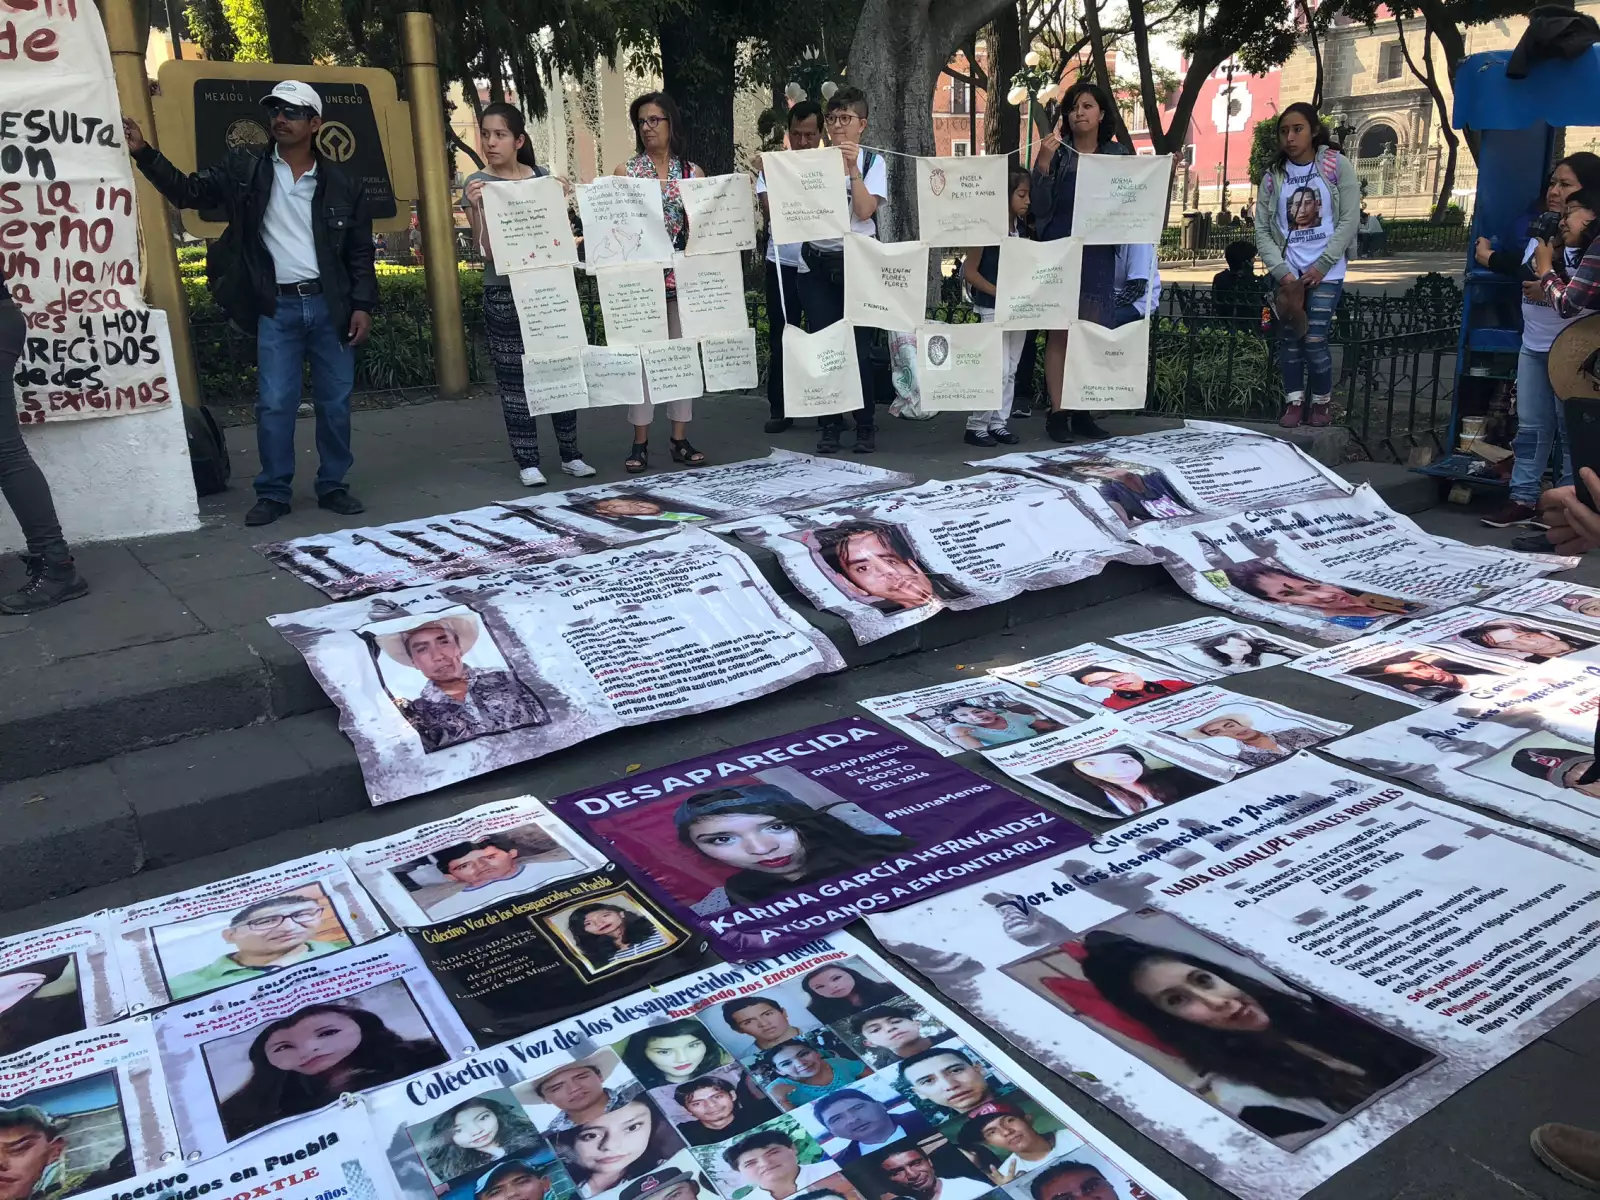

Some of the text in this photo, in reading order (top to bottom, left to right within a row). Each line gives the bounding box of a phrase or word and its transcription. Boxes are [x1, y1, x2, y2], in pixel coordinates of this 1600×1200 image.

[204, 92, 243, 102] MEXICO
[325, 95, 364, 104] UNESCO
[95, 177, 133, 216] in
[0, 214, 114, 254] erno
[103, 309, 150, 337] HOY
[654, 663, 746, 689] Camisa cuadros color
[692, 661, 716, 672] frontal
[691, 683, 706, 692] azul
[727, 671, 749, 684] botas
[617, 708, 633, 717] con
[574, 727, 879, 816] DESAPARECIDA
[846, 757, 903, 779] EL 26 DE
[856, 764, 917, 787] AGOSTO
[869, 771, 931, 793] DEL 2016
[883, 783, 992, 821] #NiUnaMenos
[1089, 818, 1169, 854] Colectivo
[1160, 788, 1404, 898] NADIA GUADALUPE MORALES ROSALES
[1329, 834, 1366, 854] OCTUBRE
[1351, 838, 1377, 855] LOMAS
[995, 793, 1300, 916] Voz de los desaparecidos en Puebla
[1312, 850, 1387, 886] ESTADO PUEBLA
[273, 863, 335, 886] CARRERA
[709, 811, 1056, 938] KARINA GARCÍA HERNÁNDEZ
[1341, 852, 1405, 886] EDAD DE AÑOS
[760, 834, 1056, 945] AYÚDANOS A ENCONTRARLA
[422, 875, 614, 944] Colectivo Voz de desaparecidos en Puebla
[25, 930, 92, 950] ROSALES
[491, 934, 537, 956] ROSALES
[366, 963, 407, 978] Puebla
[466, 955, 529, 982] desapareció
[473, 952, 512, 970] 17 años
[1434, 959, 1487, 991] particulares:
[1482, 941, 1513, 962] cicatriz
[1519, 926, 1543, 941] parte
[455, 961, 561, 1000] Lomas de San Miguel
[469, 961, 536, 990] el 27/10/2017
[669, 949, 850, 1021] Buscando nos Encontramos
[196, 1006, 254, 1029] KARINA
[310, 960, 392, 988] HERNÁNDEZ
[209, 1003, 225, 1013] de
[243, 1017, 260, 1028] 27
[261, 1010, 279, 1019] de
[320, 988, 344, 1000] del
[342, 981, 373, 992] 2016
[1511, 975, 1572, 1017] zapatos negros
[54, 1031, 121, 1052] en Puebla
[406, 953, 773, 1107] Colectivo Voz de los desaparecidos en
[54, 1038, 129, 1063] LINARES
[103, 1048, 149, 1066] 26 años
[39, 1071, 73, 1084] 2017
[45, 1056, 95, 1074] Puebla
[229, 1131, 340, 1183] en Puebla
[222, 1167, 320, 1200] OXTLE
